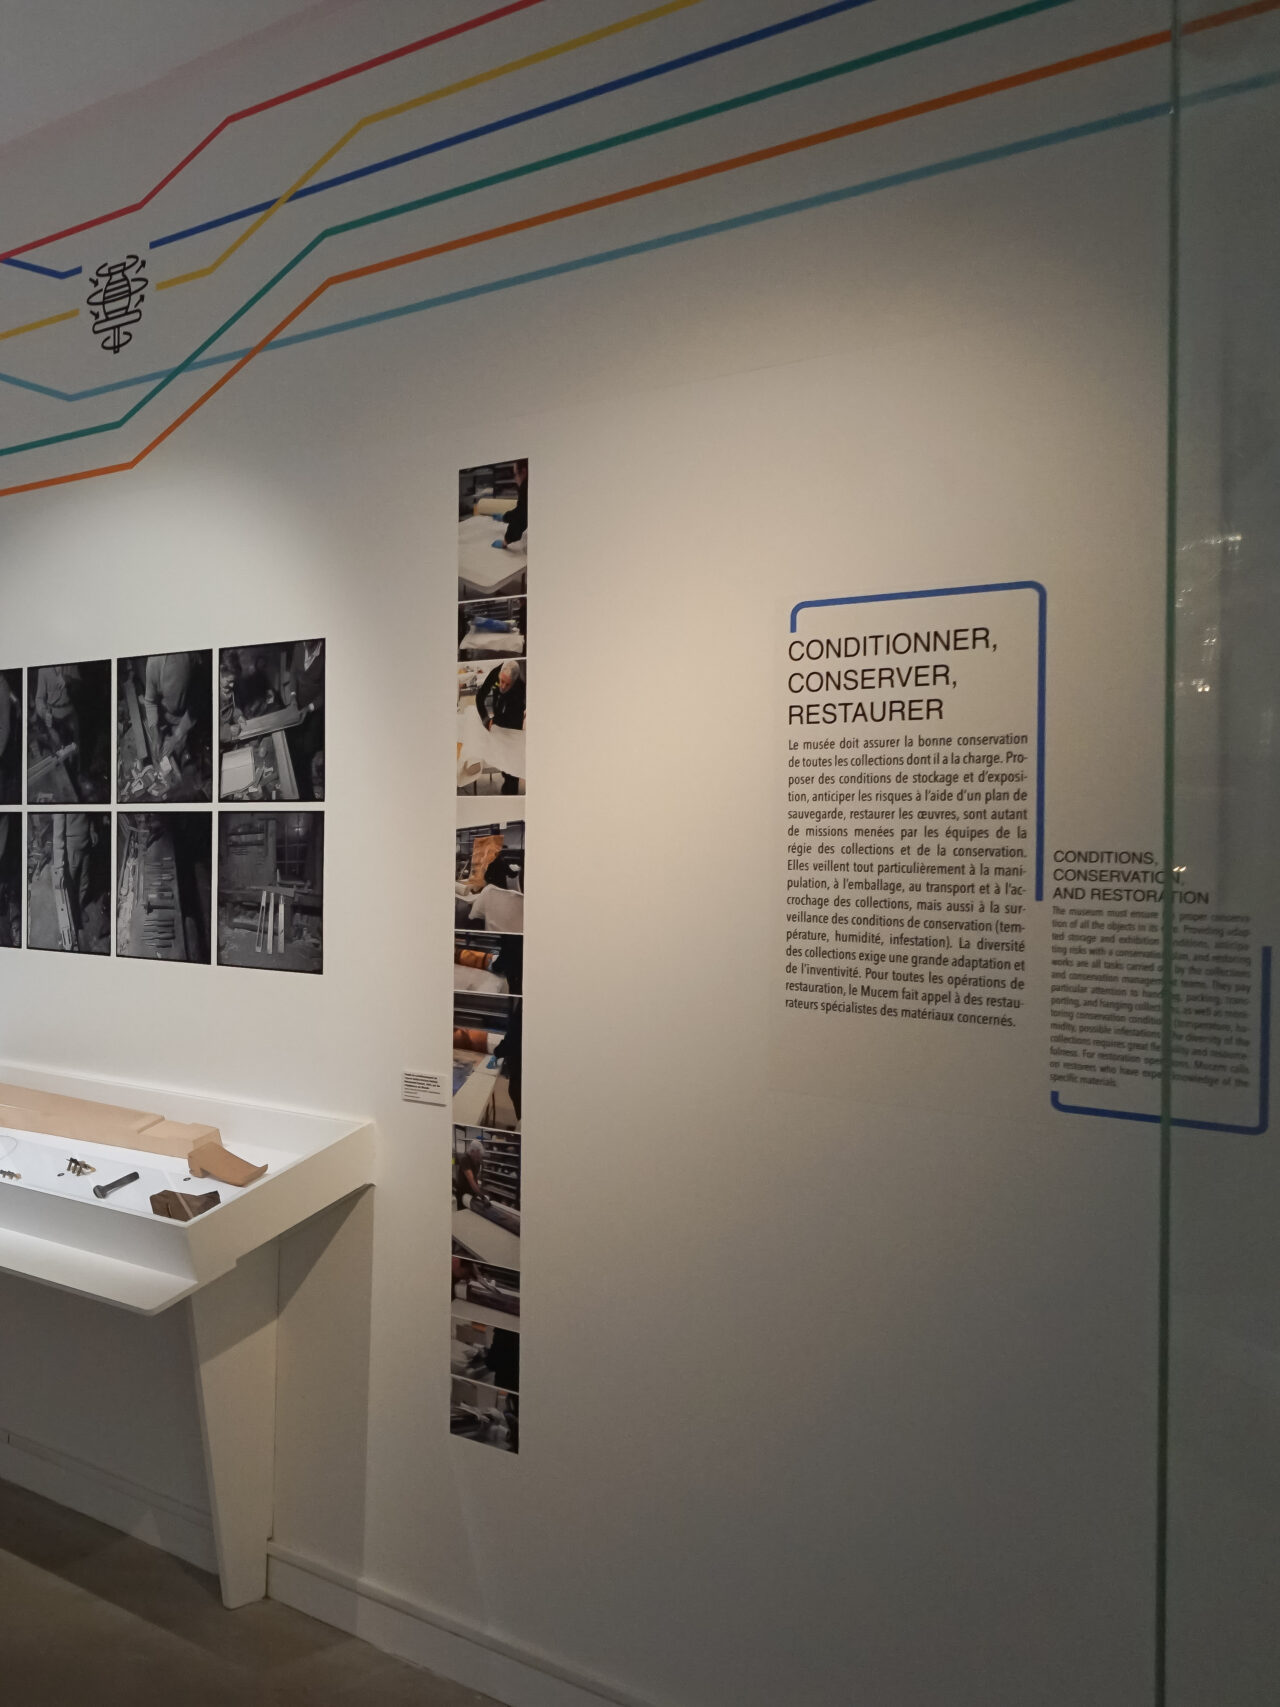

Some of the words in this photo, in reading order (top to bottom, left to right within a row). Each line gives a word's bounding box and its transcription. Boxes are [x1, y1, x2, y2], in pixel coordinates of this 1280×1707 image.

[788, 626, 998, 661] CONDITIONNER,
[788, 664, 958, 693] CONSERVER,
[788, 698, 943, 725] RESTAURER
[788, 739, 798, 750] Le
[802, 737, 835, 749] musée
[838, 736, 859, 749] doit
[862, 738, 900, 748] assurer
[904, 735, 913, 747] la
[918, 734, 952, 746] bonne
[956, 732, 1028, 746] conservation
[788, 755, 800, 767] de
[802, 756, 832, 767] toutes
[834, 754, 848, 766] les
[850, 753, 904, 766] collections
[906, 752, 931, 765] dont
[932, 751, 940, 764] il
[941, 755, 948, 764] a
[950, 751, 960, 764] la
[962, 751, 1003, 767] charge.
[1005, 750, 1028, 763] Pro-
[788, 776, 815, 788] poser
[817, 772, 835, 784] des
[838, 771, 892, 784] conditions
[894, 771, 908, 783] de
[912, 770, 959, 786] stockage
[962, 771, 974, 782] et
[977, 769, 1028, 786] d'exposi-
[787, 790, 809, 803] tion,
[811, 790, 855, 805] anticiper
[858, 789, 872, 801] les
[875, 790, 913, 804] risques
[914, 790, 922, 801] à
[924, 788, 953, 801] l'aide
[956, 788, 981, 801] d'un
[984, 788, 1010, 804] plan
[1012, 788, 1028, 801] de
[787, 807, 846, 822] sauvegarde,
[849, 808, 896, 819] restaurer
[898, 807, 914, 819] les
[916, 810, 960, 821] œuvres,
[962, 808, 988, 819] sont
[990, 808, 1028, 820] autant
[787, 824, 800, 836] de
[805, 825, 848, 836] missions
[854, 825, 894, 837] menées
[900, 828, 918, 840] par
[923, 825, 939, 837] les
[944, 825, 990, 841] équipes
[995, 825, 1010, 838] de
[1016, 825, 1027, 838] la
[787, 842, 812, 856] régie
[817, 841, 835, 854] des
[840, 842, 894, 855] collections
[900, 844, 911, 855] et
[916, 843, 931, 856] de
[936, 843, 946, 856] la
[952, 845, 1027, 857] conservation.
[1053, 850, 1159, 867] CONDITIONS,
[787, 858, 809, 870] Elles
[812, 859, 850, 872] veillent
[852, 861, 874, 872] tout
[877, 861, 966, 876] particulièrement
[968, 863, 976, 875] à
[979, 862, 990, 875] la
[993, 864, 1026, 876] mani-
[786, 876, 830, 890] pulation,
[833, 877, 839, 889] à
[842, 877, 904, 894] l'emballage,
[908, 882, 921, 892] au
[925, 881, 975, 896] transport
[978, 883, 990, 894] et
[993, 882, 1001, 894] à
[1004, 881, 1026, 895] l'ac-
[1053, 887, 1086, 900] AND
[786, 893, 830, 909] crochage
[833, 894, 851, 907] des
[854, 895, 912, 911] collections,
[916, 898, 942, 911] mais
[945, 900, 974, 912] aussi
[978, 900, 985, 912] à
[989, 900, 1000, 913] la
[1004, 904, 1026, 914] sur-
[786, 910, 829, 923] veillance
[830, 912, 849, 924] des
[850, 913, 904, 927] conditions
[906, 915, 920, 928] de
[923, 919, 992, 931] conservation
[994, 919, 1025, 934] (tem-
[786, 928, 829, 942] pérature,
[834, 929, 884, 945] humidité,
[889, 932, 952, 950] infestation).
[958, 936, 971, 949] La
[976, 937, 1025, 952] diversité
[785, 944, 802, 957] des
[804, 946, 856, 960] collections
[858, 950, 887, 965] exige
[888, 954, 909, 963] une
[910, 953, 949, 967] grande
[950, 954, 1011, 971] adaptation
[1013, 960, 1025, 971] et
[785, 961, 799, 974] de
[800, 962, 861, 978] l'inventivité.
[864, 967, 889, 980] Pour
[891, 970, 924, 983] toutes
[928, 970, 944, 984] les
[946, 973, 1006, 988] opérations
[1009, 976, 1025, 990] de
[785, 981, 846, 996] restauration,
[848, 983, 858, 995] le
[860, 984, 898, 998] Mucem
[901, 986, 918, 1000] fait
[920, 990, 952, 1005] appel
[954, 991, 961, 1003] à
[962, 991, 983, 1005] des
[985, 996, 1024, 1008] restau-
[785, 998, 818, 1010] rateurs
[820, 1000, 878, 1015] spécialistes
[879, 1003, 898, 1017] des
[900, 1007, 954, 1021] matériaux
[956, 1013, 1016, 1027] concernés.
